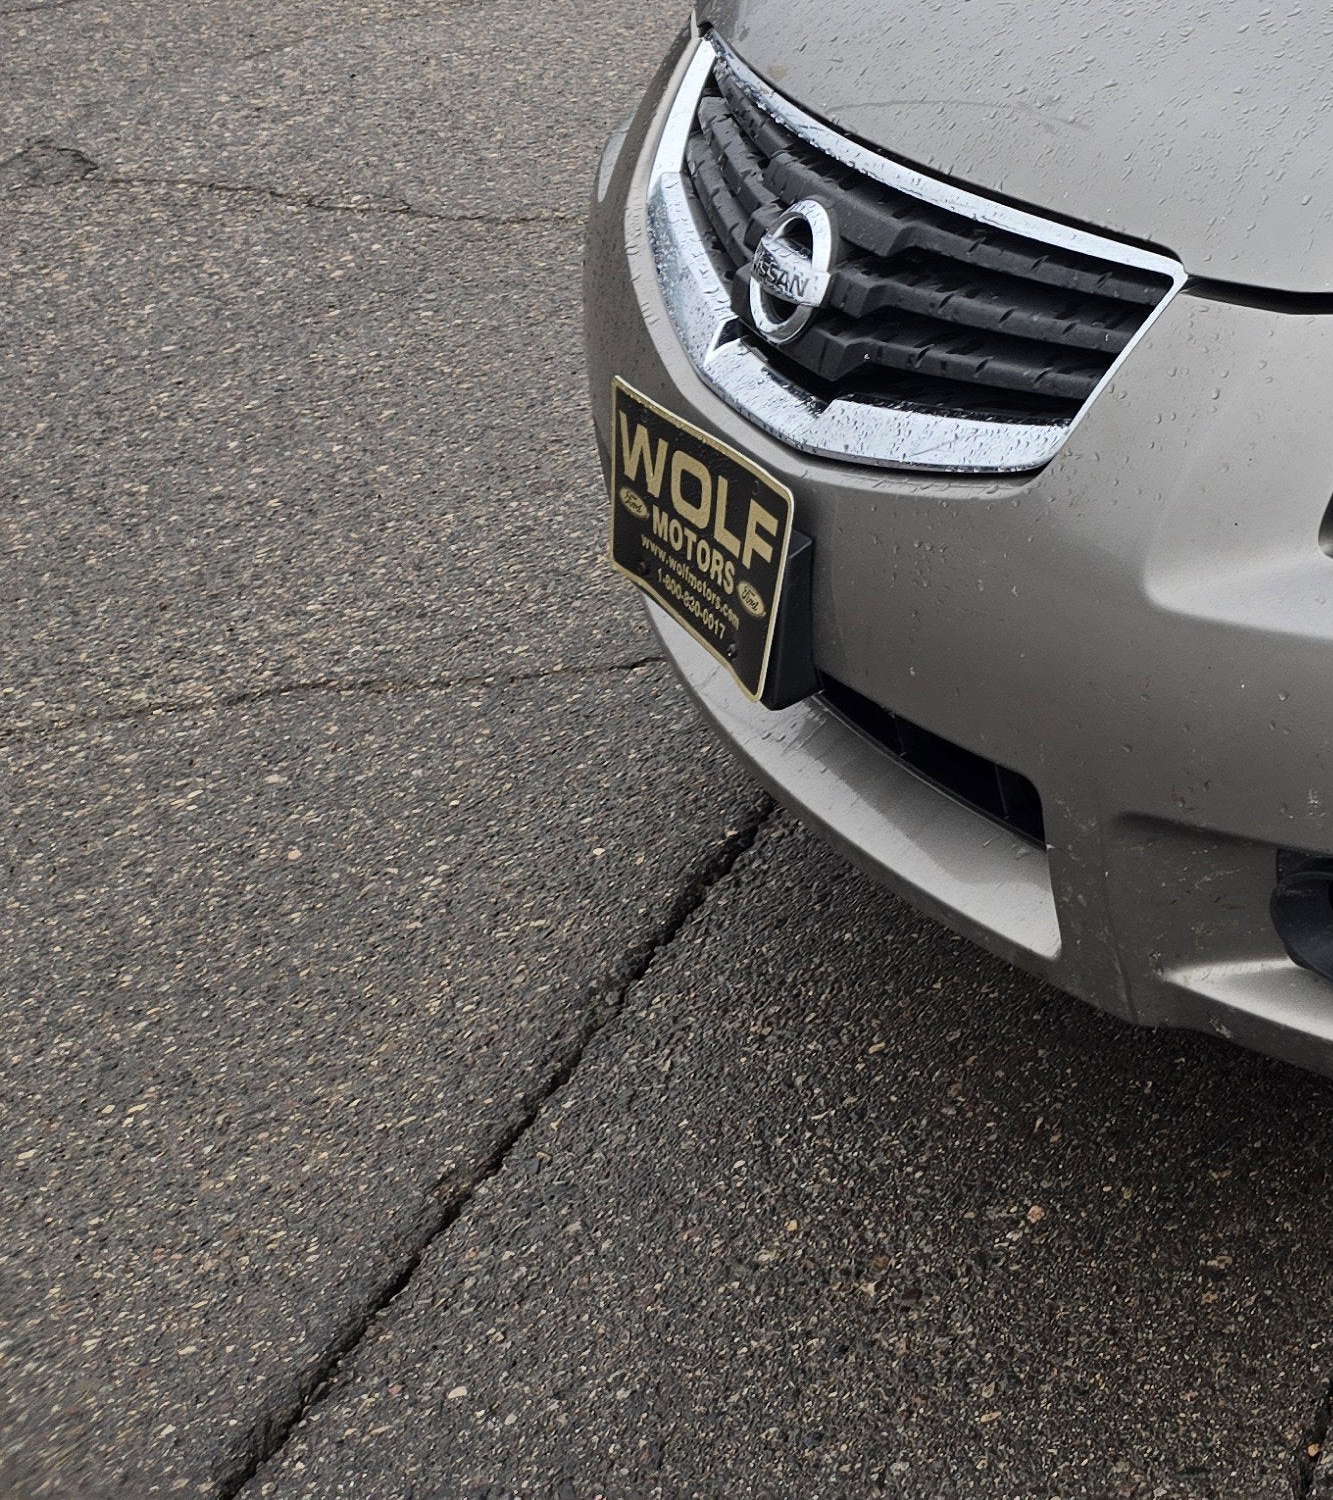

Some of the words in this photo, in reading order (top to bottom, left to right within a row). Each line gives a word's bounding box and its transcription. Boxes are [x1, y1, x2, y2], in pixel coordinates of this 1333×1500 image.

[619, 410, 778, 569] WOLF
[642, 534, 740, 630] www.wolfmotors.com
[653, 505, 736, 595] MOTORS
